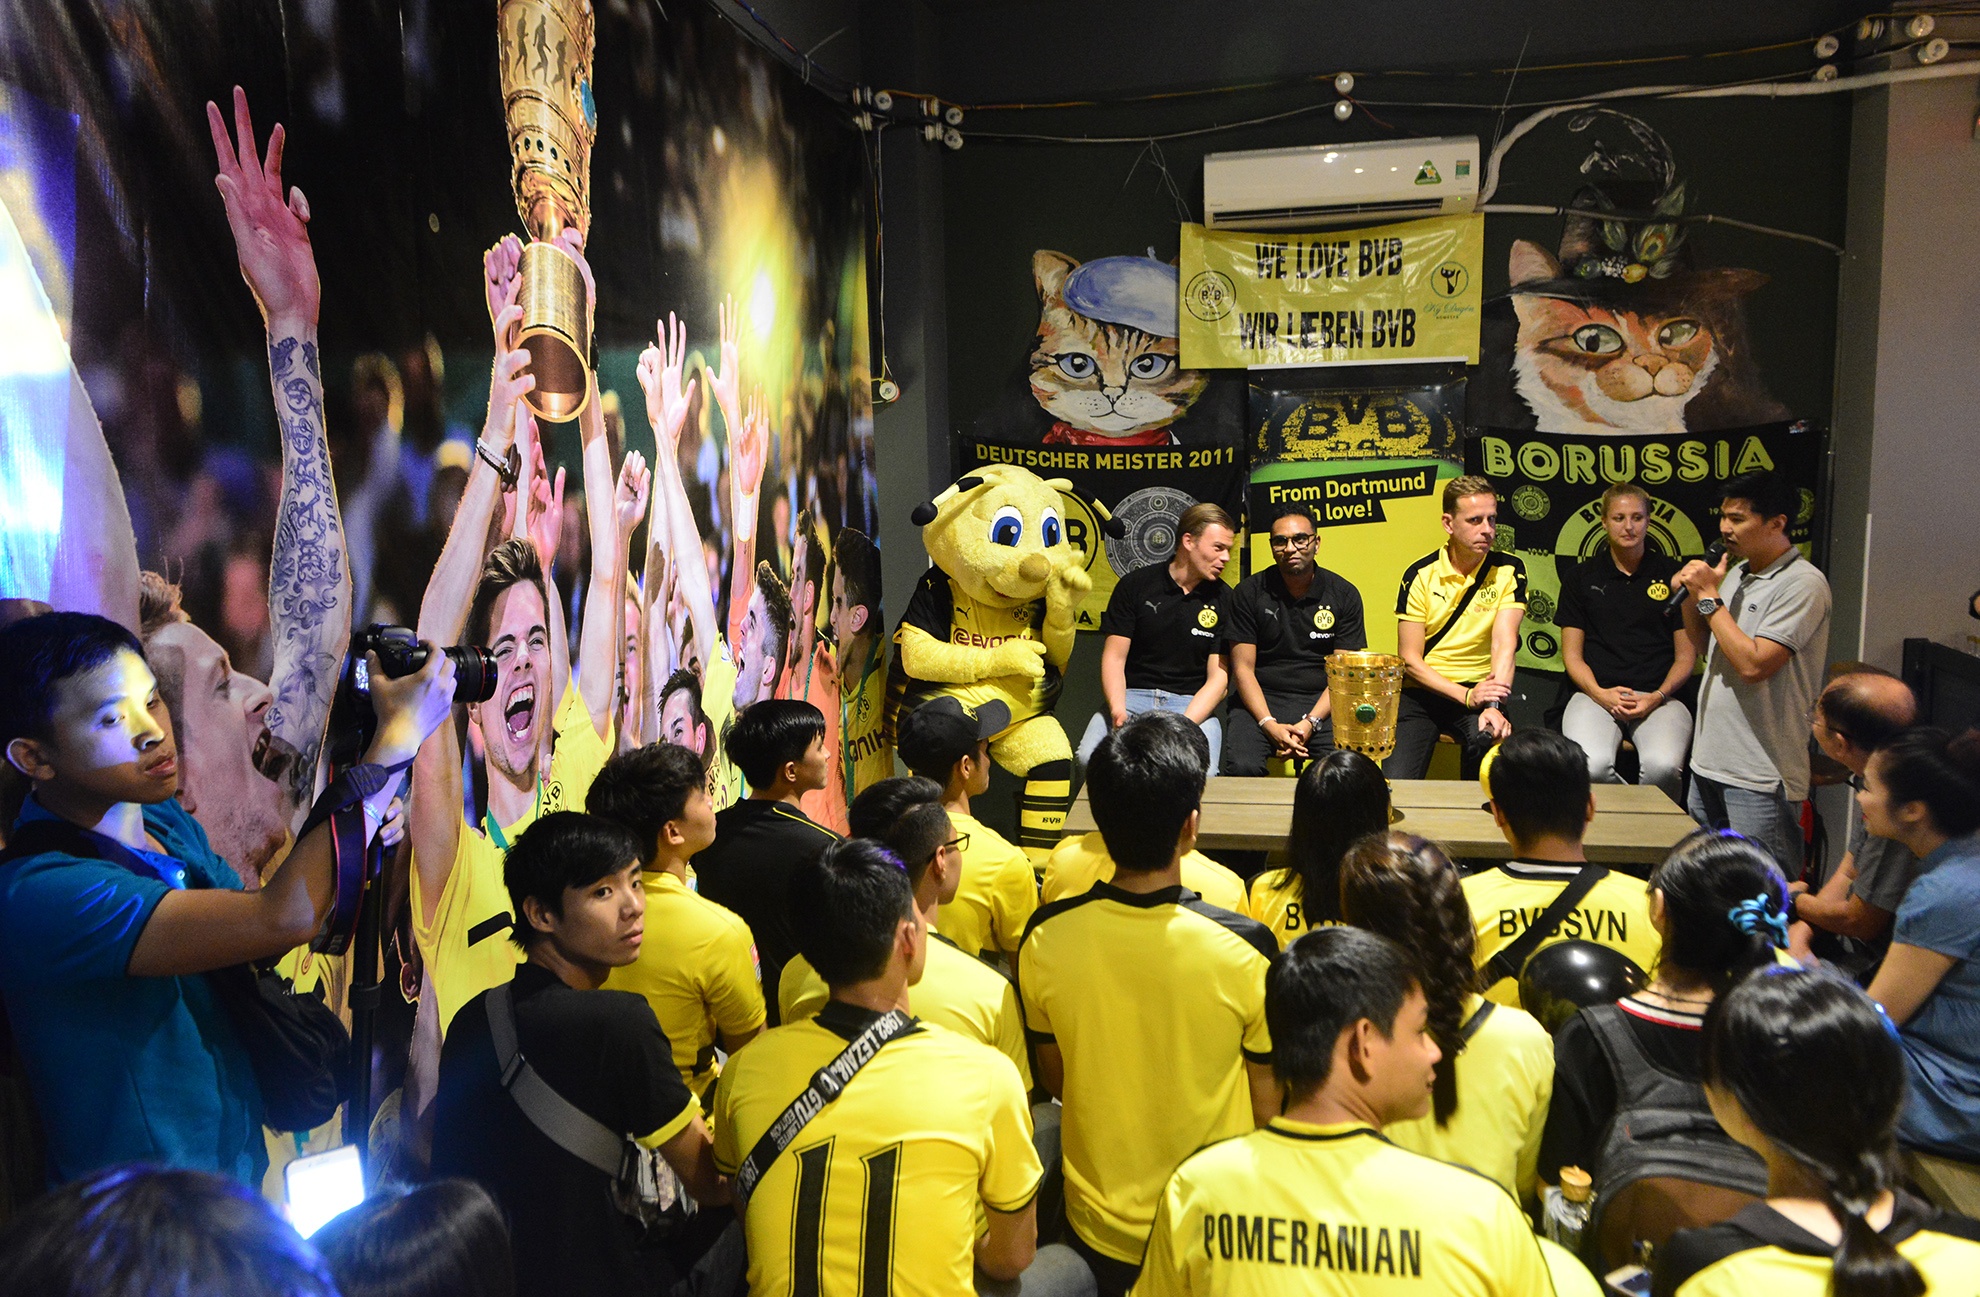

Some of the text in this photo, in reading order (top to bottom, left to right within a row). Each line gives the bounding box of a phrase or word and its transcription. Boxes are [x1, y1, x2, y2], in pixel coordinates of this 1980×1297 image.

[1255, 237, 1403, 279] WE LOVE BVB
[1239, 308, 1416, 349] WIR LIEBEN BVB
[976, 443, 1234, 470] DEUTSCHER MEISTER 2011
[1480, 435, 1775, 485] BORUSSIA
[1269, 471, 1426, 504] From Dortmund
[1325, 499, 1373, 521] love!
[1480, 587, 1497, 599] BVB
[1650, 585, 1668, 595] BVB
[1013, 608, 1029, 618] BVB
[1201, 611, 1216, 624] BVB
[1316, 612, 1333, 625] BVB
[788, 1135, 903, 1297] 11
[1203, 1213, 1423, 1279] POMERANIAN
